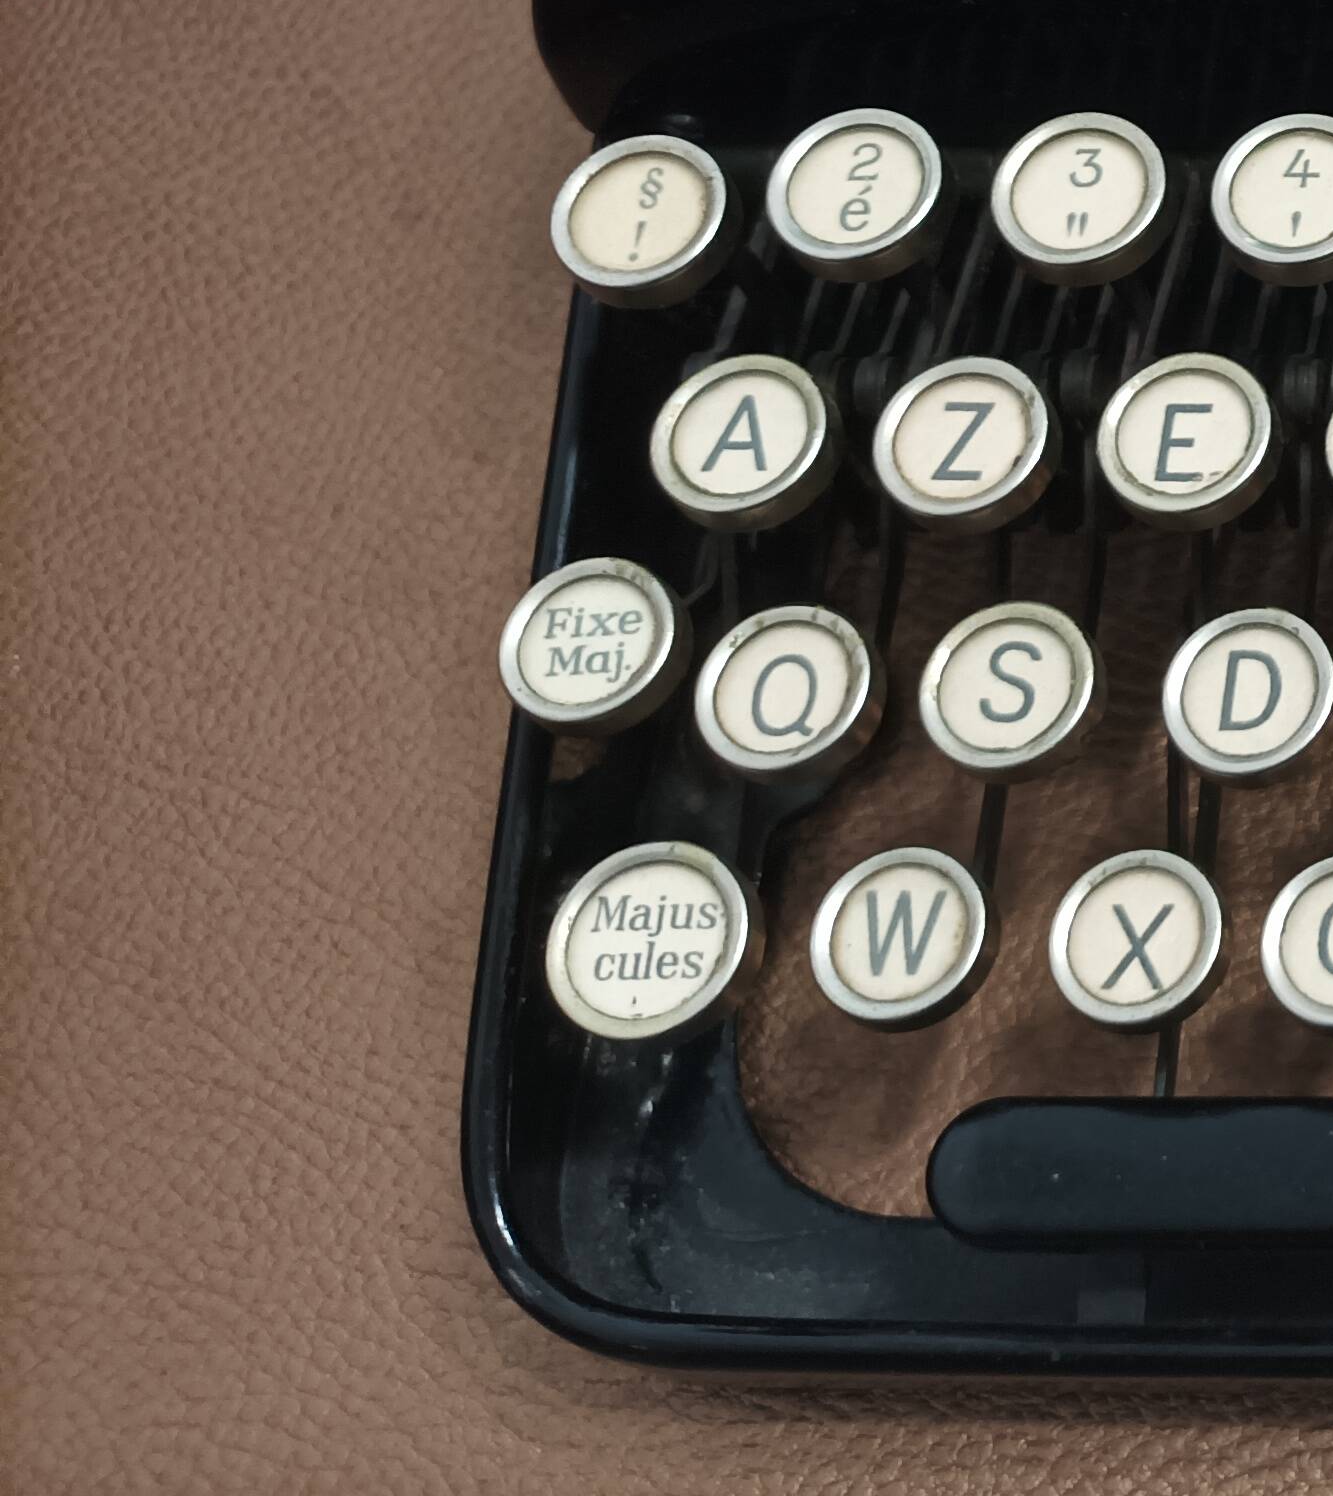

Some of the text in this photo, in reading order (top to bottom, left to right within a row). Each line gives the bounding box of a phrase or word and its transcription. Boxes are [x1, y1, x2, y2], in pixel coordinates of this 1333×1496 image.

[848, 143, 882, 181] 2
[1070, 149, 1102, 187] 3
[1283, 149, 1320, 188] 4
[639, 167, 663, 209] §
[839, 185, 872, 231] é
[628, 221, 646, 262] !
[701, 395, 766, 472] A
[931, 402, 995, 481] Z
[1154, 404, 1212, 482] E
[545, 606, 644, 641] Fixe
[545, 642, 634, 682] Maj.
[980, 642, 1042, 723] S
[751, 655, 817, 736] Q
[1219, 650, 1281, 731] D
[864, 889, 948, 977] W
[1100, 903, 1174, 992] X
[594, 941, 705, 981] cules
